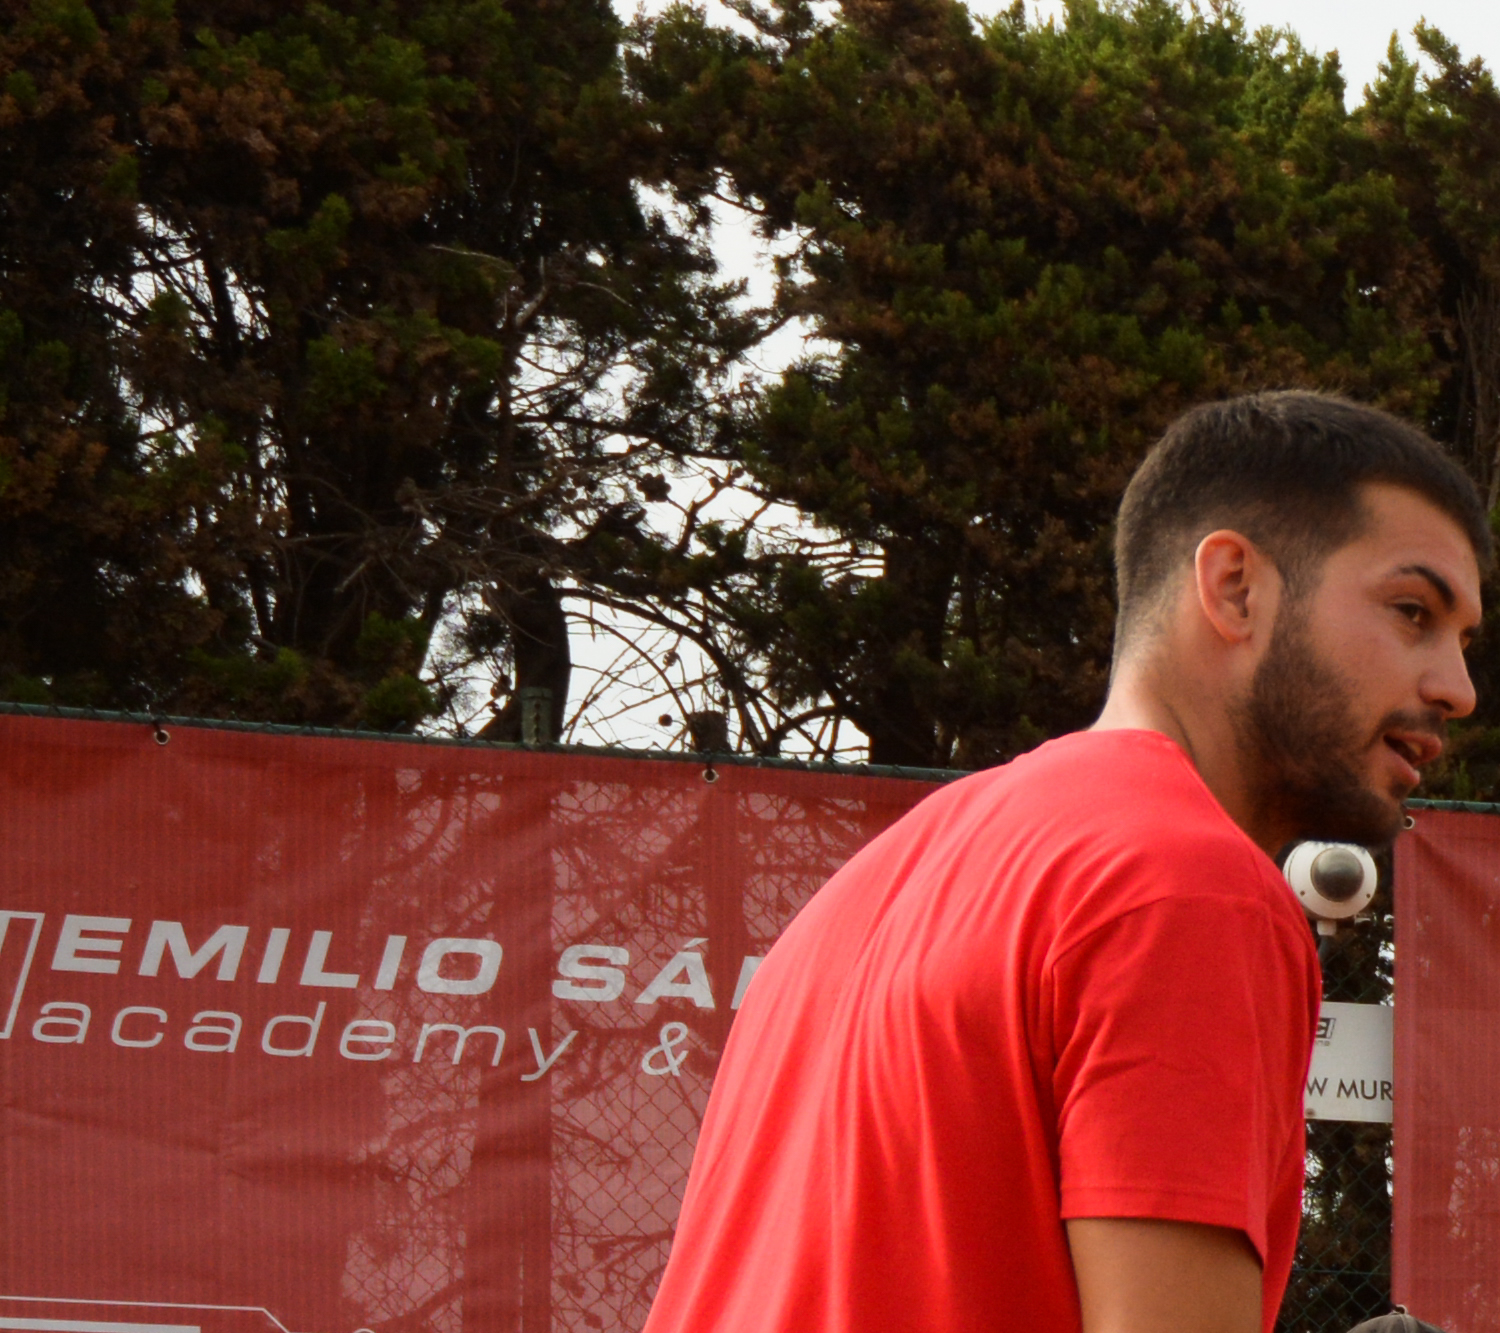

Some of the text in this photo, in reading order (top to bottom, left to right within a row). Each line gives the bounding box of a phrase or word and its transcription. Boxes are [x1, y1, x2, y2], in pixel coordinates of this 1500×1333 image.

[51, 913, 766, 1010] EMILIO SÁ
[32, 1002, 692, 1082] academy &
